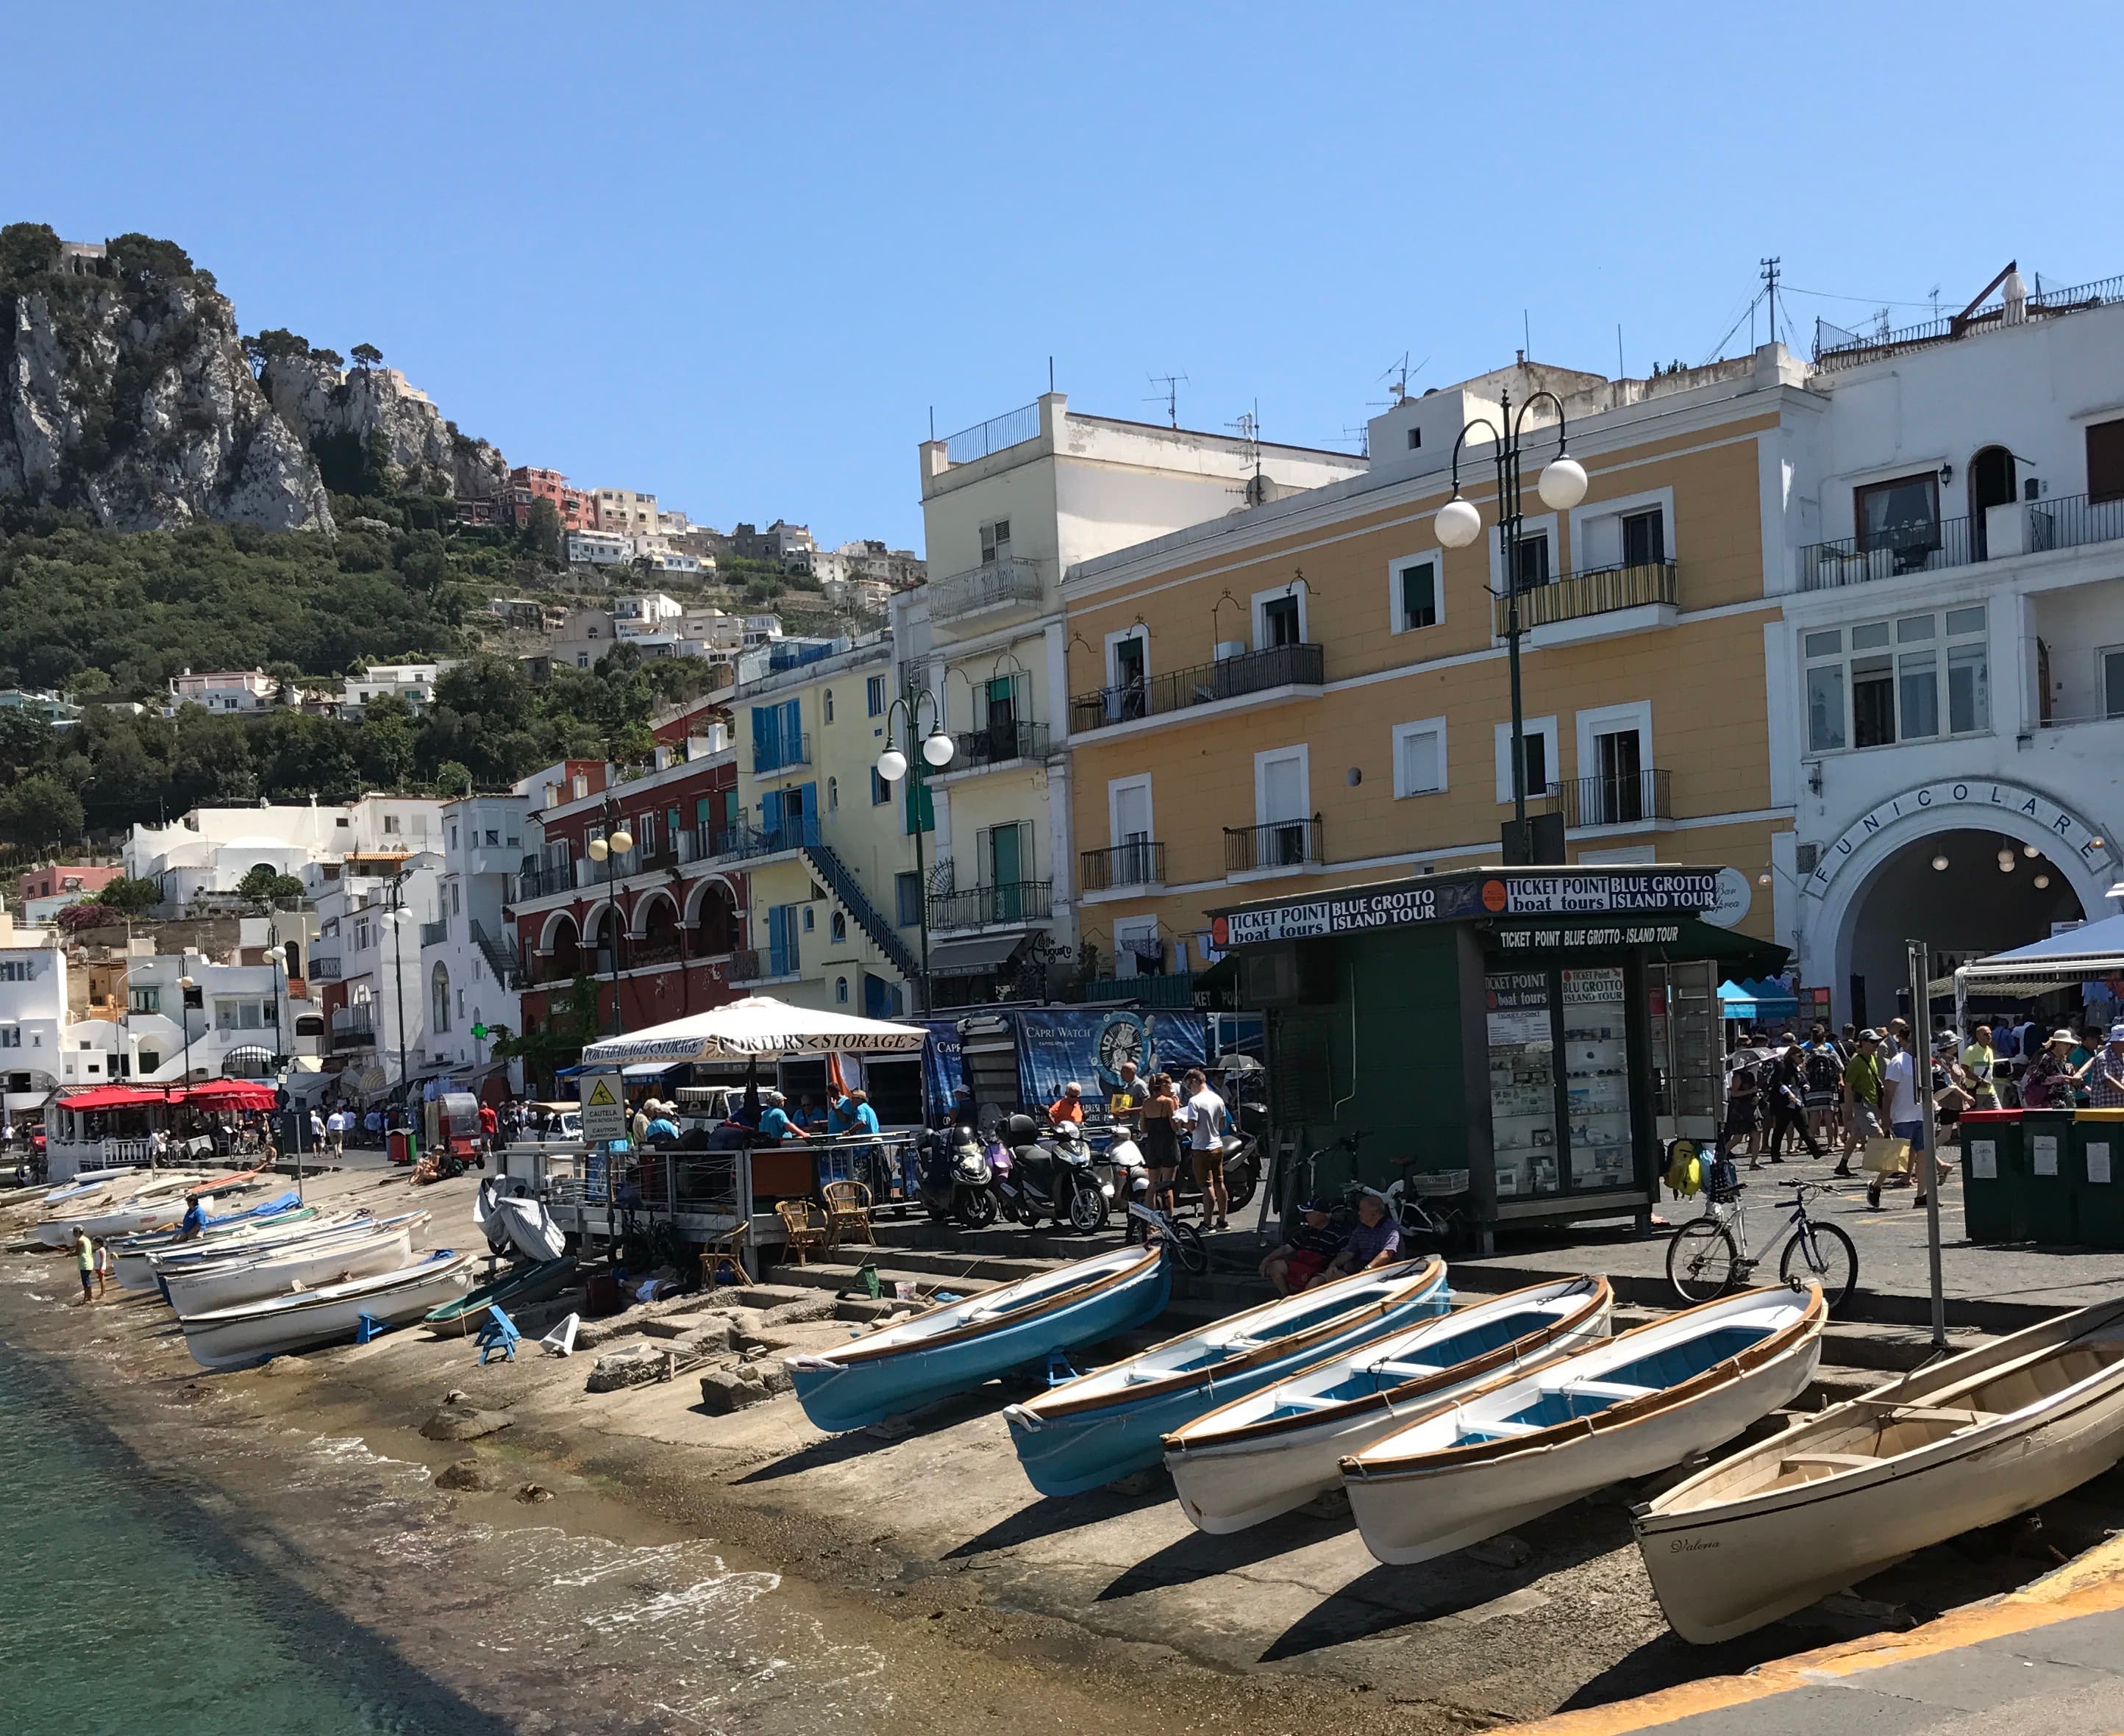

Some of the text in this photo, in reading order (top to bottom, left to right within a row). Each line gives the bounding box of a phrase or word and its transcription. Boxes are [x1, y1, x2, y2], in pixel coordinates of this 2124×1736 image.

[1814, 784, 2095, 883] FUNICOLARE
[1507, 878, 1558, 896] TICKET
[1562, 876, 1609, 895] POINT
[1611, 876, 1648, 893] BLUE
[1652, 875, 1714, 893] GROTTO
[1715, 882, 1736, 896] Bar
[1230, 889, 1435, 930] TICKET POINT BLUE GROTTO
[1513, 895, 1551, 912] boat
[1561, 895, 1604, 910] tours
[1611, 893, 1667, 909] ISLAND
[1670, 891, 1716, 907] TOUR
[1234, 904, 1436, 943] boat tours ISLAND TOUR
[1500, 931, 1531, 948] TICKET
[1535, 930, 1560, 946] POINT
[1564, 929, 1586, 946] BLUE
[1586, 928, 1621, 946] GROTTO
[1625, 927, 1655, 944] ISLAND
[1656, 926, 1679, 942] TOUR
[1028, 931, 1072, 964] Augusto
[1484, 973, 1546, 990] TICKET POINT
[1573, 970, 1611, 981] TICKET Point
[1562, 979, 1623, 993] BLU GROTTO
[1497, 992, 1547, 1007] boat tours
[1564, 991, 1623, 1003] ISLAND TOUR
[719, 1034, 908, 1053] PORTERS STORAGE
[589, 1110, 617, 1118] CAUTELA
